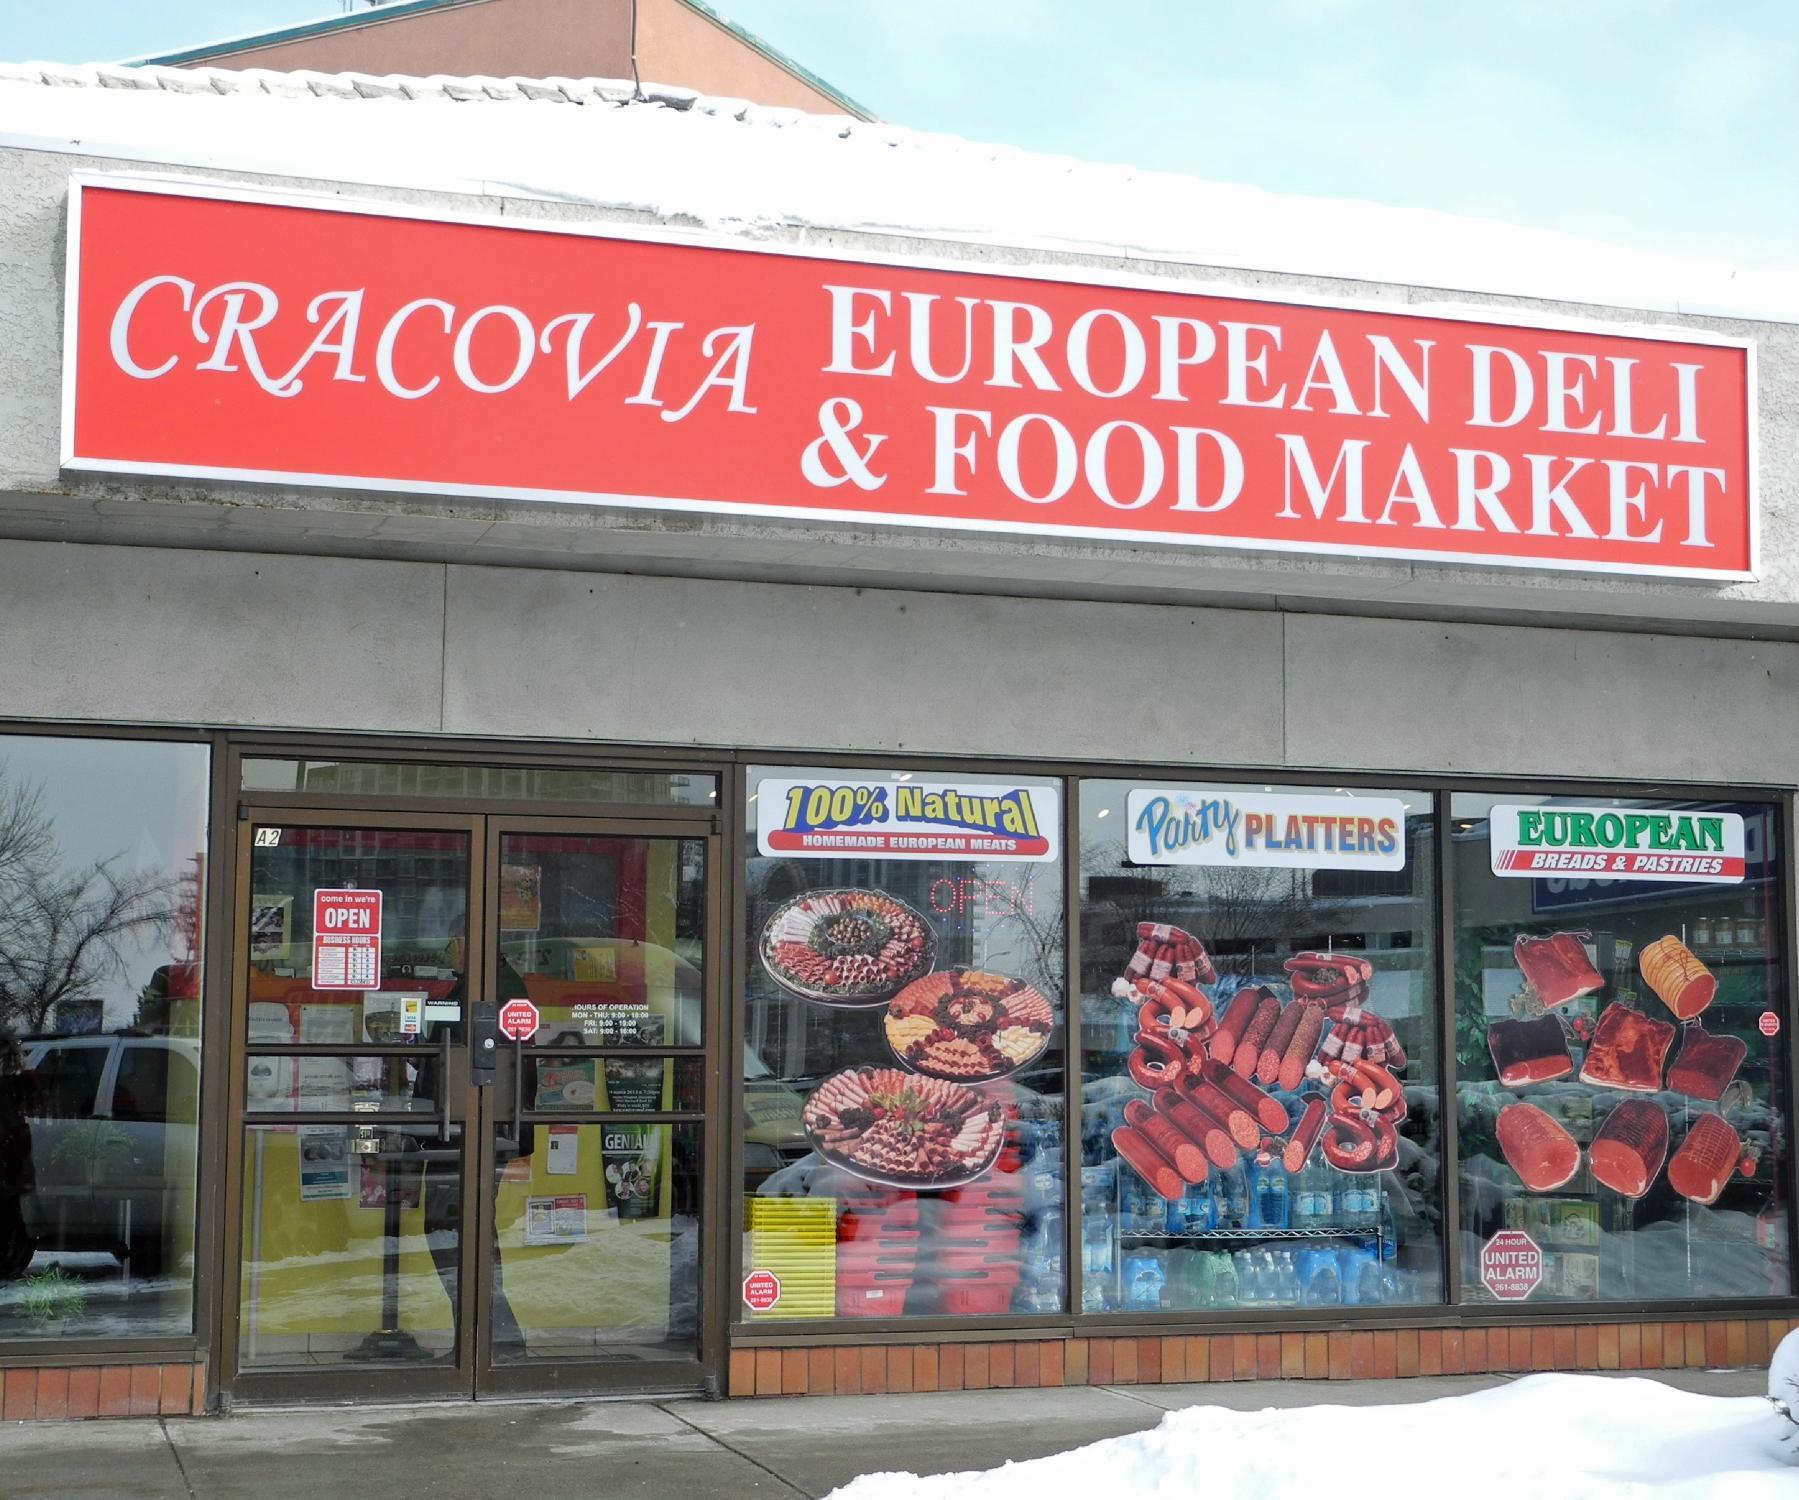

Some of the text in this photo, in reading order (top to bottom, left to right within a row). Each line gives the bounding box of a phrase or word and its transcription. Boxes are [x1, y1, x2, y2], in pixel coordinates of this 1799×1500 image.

[109, 274, 758, 422] CRACOVIA
[821, 284, 1706, 445] EUROPEAN DELI
[800, 396, 1728, 549] & FOOD MARKET
[783, 785, 1041, 839] 100% Natural
[1136, 796, 1399, 858] Party PLATTERS
[803, 834, 1017, 851] HOMEMADE EUROPEAN MEATS
[1517, 809, 1725, 851] EUROPEAN
[1530, 852, 1723, 875] BREADS & PASTRIES
[355, 895, 376, 903] we're
[930, 879, 1033, 917] OPEN
[324, 907, 370, 928] OPEN
[1496, 1238, 1527, 1246] 24 HOUR
[1485, 1252, 1538, 1264] UNITED
[1486, 1267, 1537, 1280] ALARM
